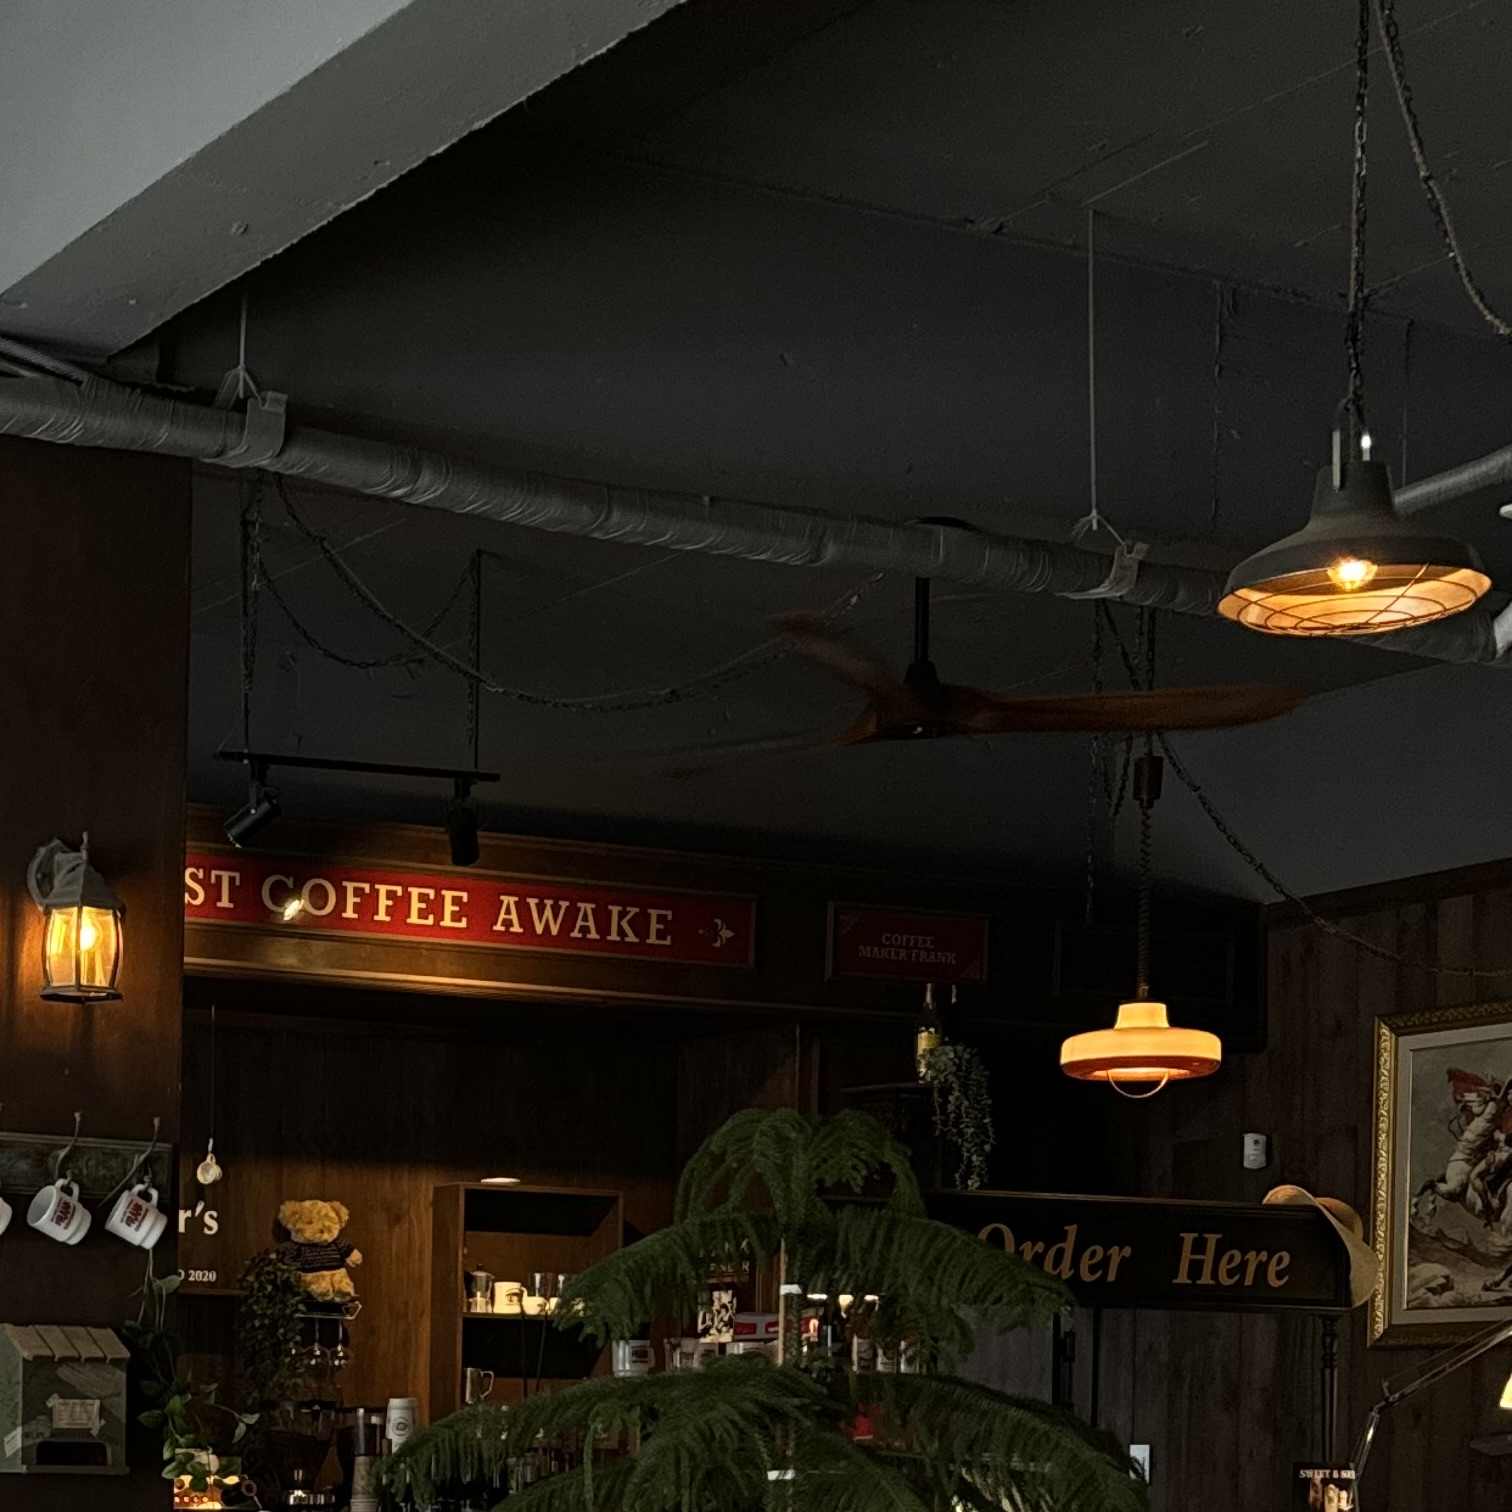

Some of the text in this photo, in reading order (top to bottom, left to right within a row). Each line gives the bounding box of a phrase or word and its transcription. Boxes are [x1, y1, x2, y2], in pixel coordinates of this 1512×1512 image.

[184, 867, 673, 946] ST COFFEE AWAKE
[881, 933, 935, 949] COFFEE
[188, 1269, 218, 1282] 2020
[1172, 1231, 1292, 1289] Here
